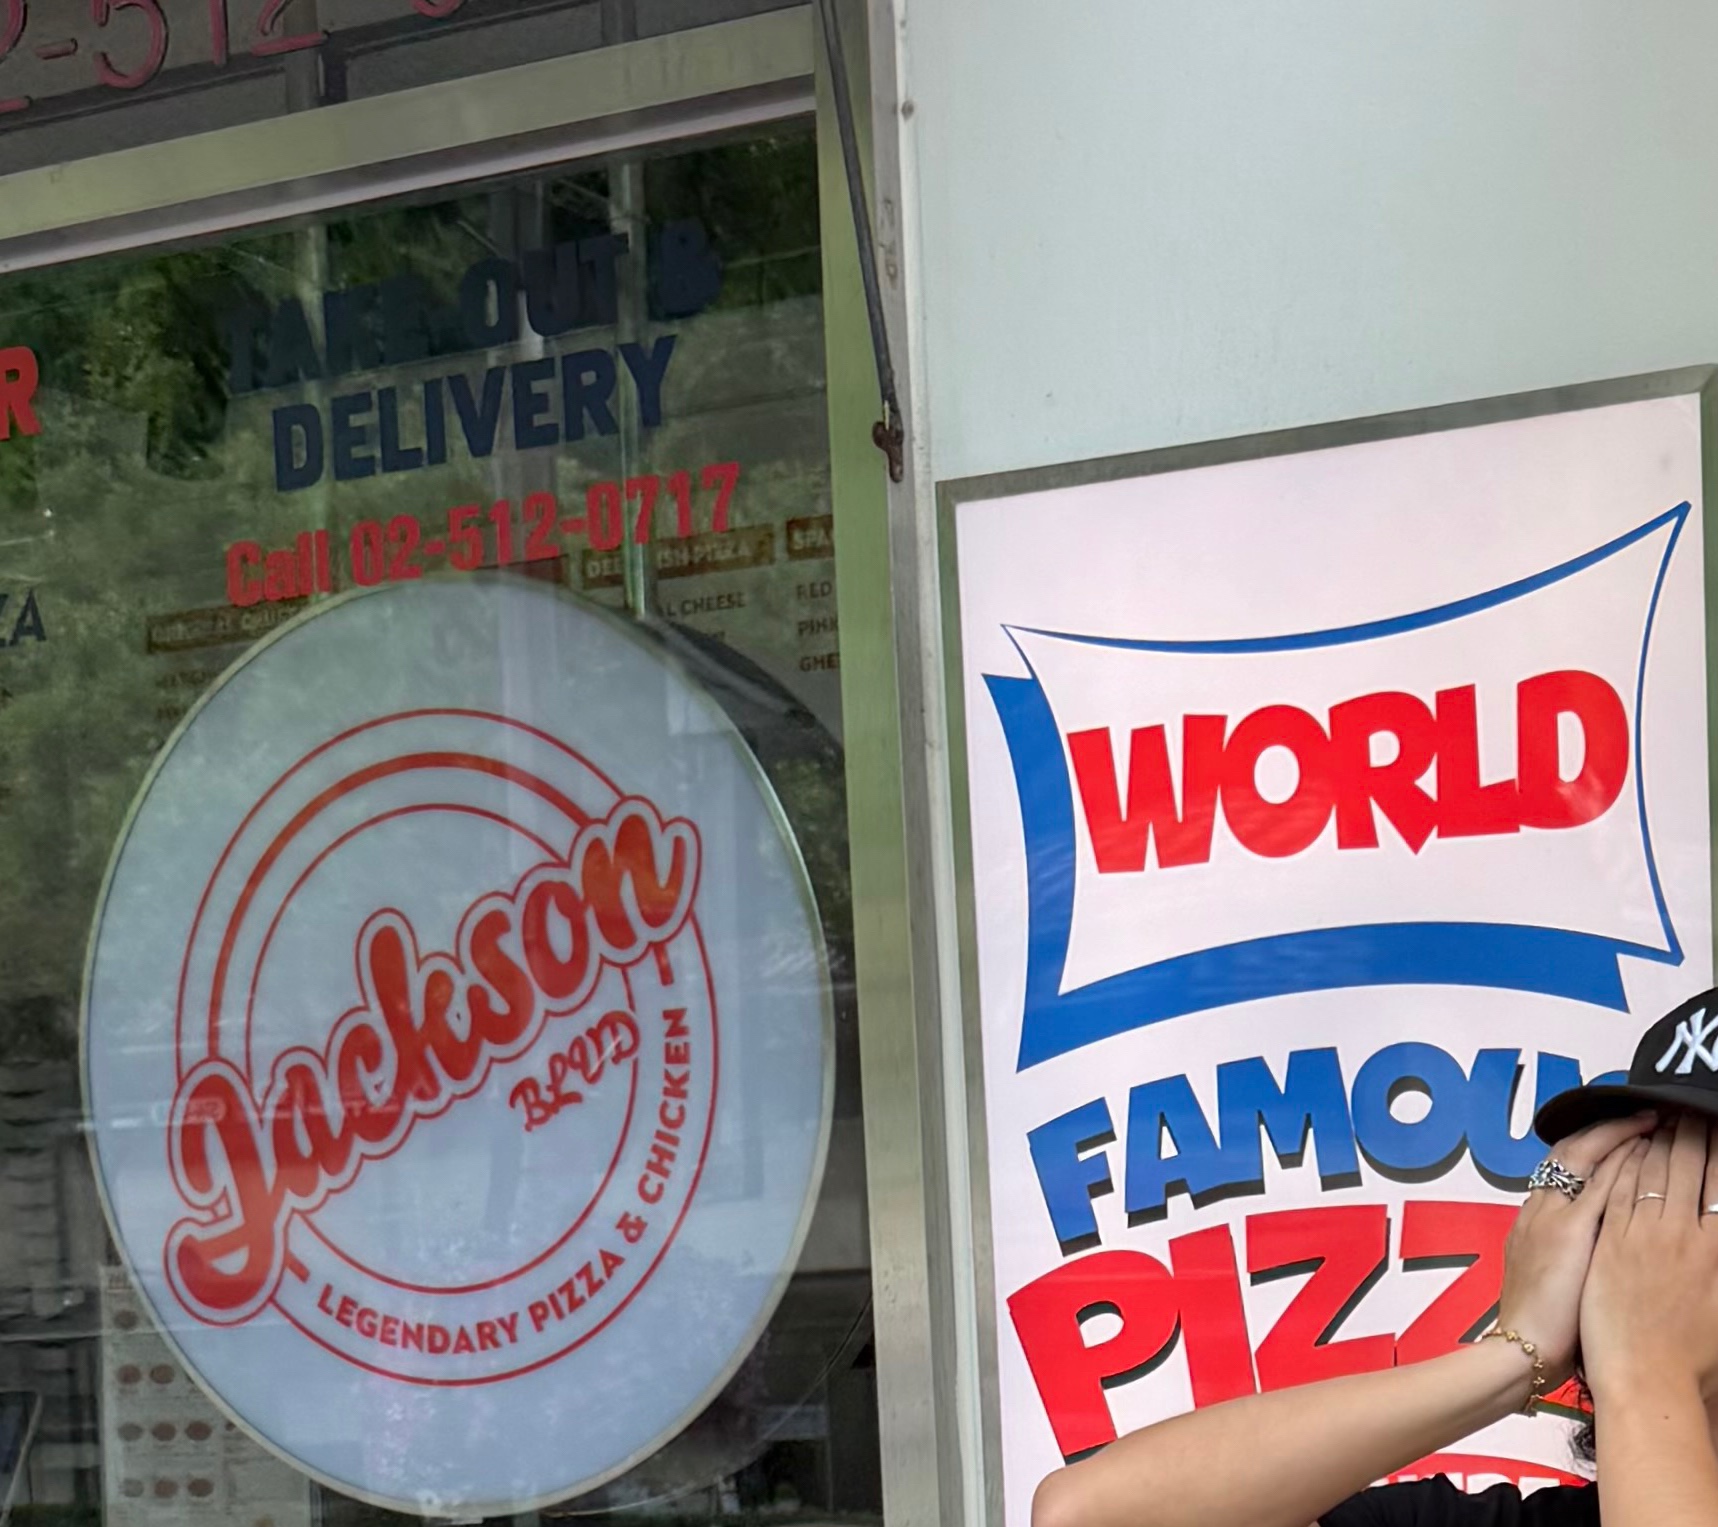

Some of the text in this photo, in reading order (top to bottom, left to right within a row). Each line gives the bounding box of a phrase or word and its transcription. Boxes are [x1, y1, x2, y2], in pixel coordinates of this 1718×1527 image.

[458, 232, 631, 345] OUT
[272, 334, 678, 493] DELIVERY
[225, 461, 740, 608] Call 02-512-0717
[680, 591, 747, 617] CHEESE
[796, 581, 833, 600] RED
[800, 651, 841, 673] GHE
[1066, 669, 1630, 875] WORLD
[168, 802, 695, 1320] Jackson
[316, 1006, 692, 1355] LEGENDARY PIZZA & CHICKEN
[1027, 1041, 1630, 1257] FAMOU
[1006, 1200, 1594, 1466] PIZZ
